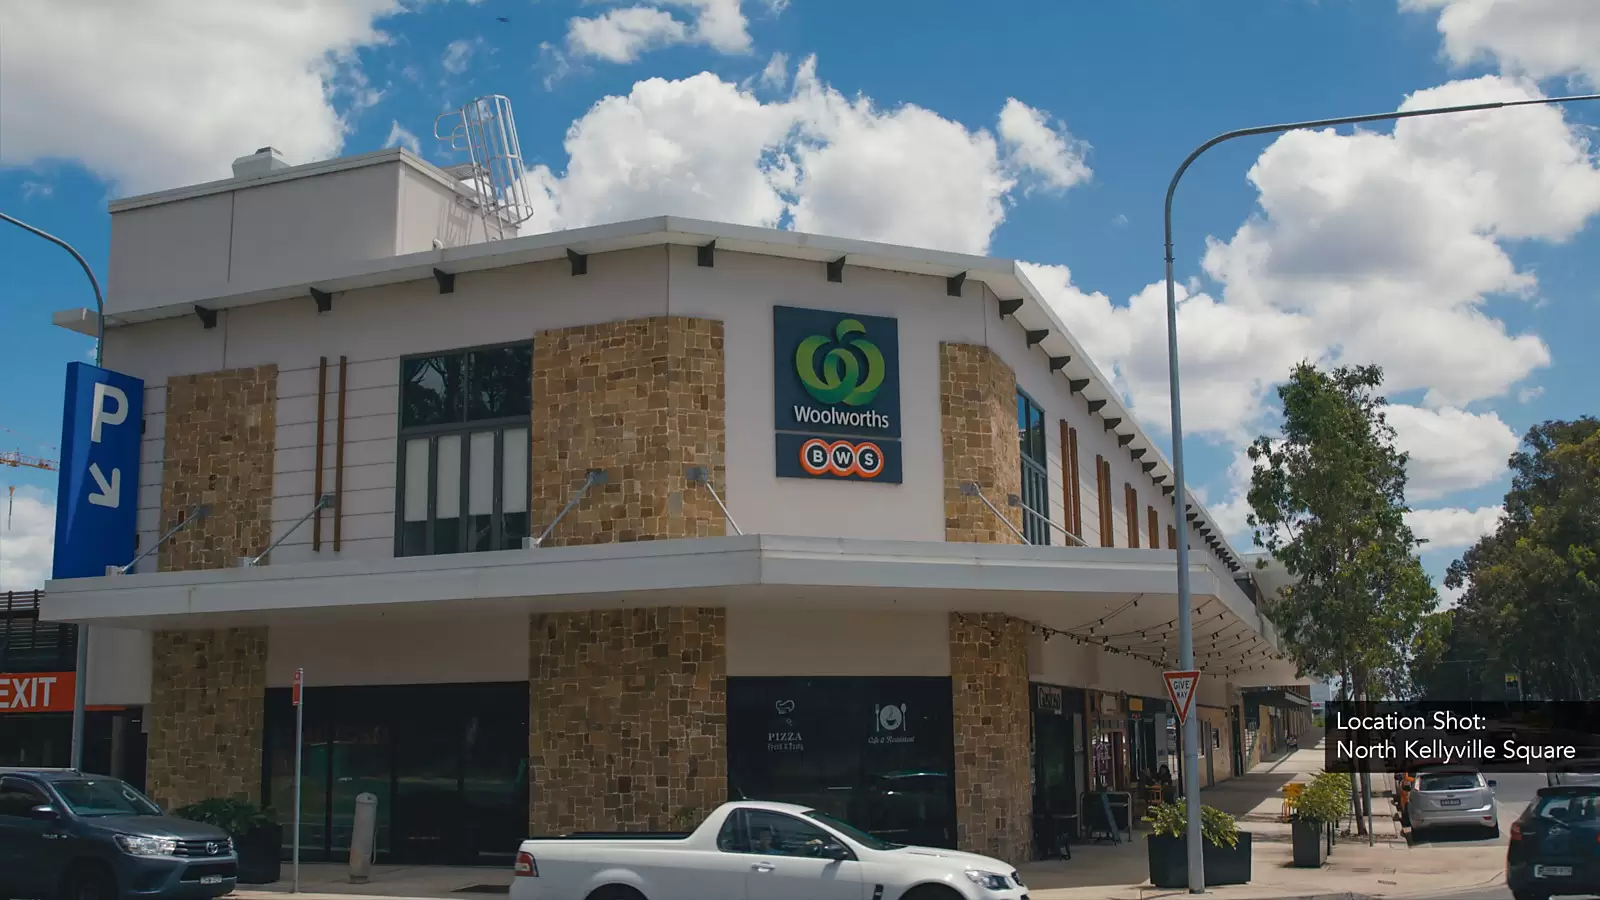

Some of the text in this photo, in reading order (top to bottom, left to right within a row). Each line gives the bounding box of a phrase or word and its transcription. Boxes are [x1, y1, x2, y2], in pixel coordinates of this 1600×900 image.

[91, 382, 129, 444] P
[793, 405, 889, 429] Woolworths
[0, 677, 57, 709] EXIT
[1173, 680, 1190, 690] GIVE
[1177, 691, 1188, 699] WAY
[768, 732, 803, 741] PIZZA
